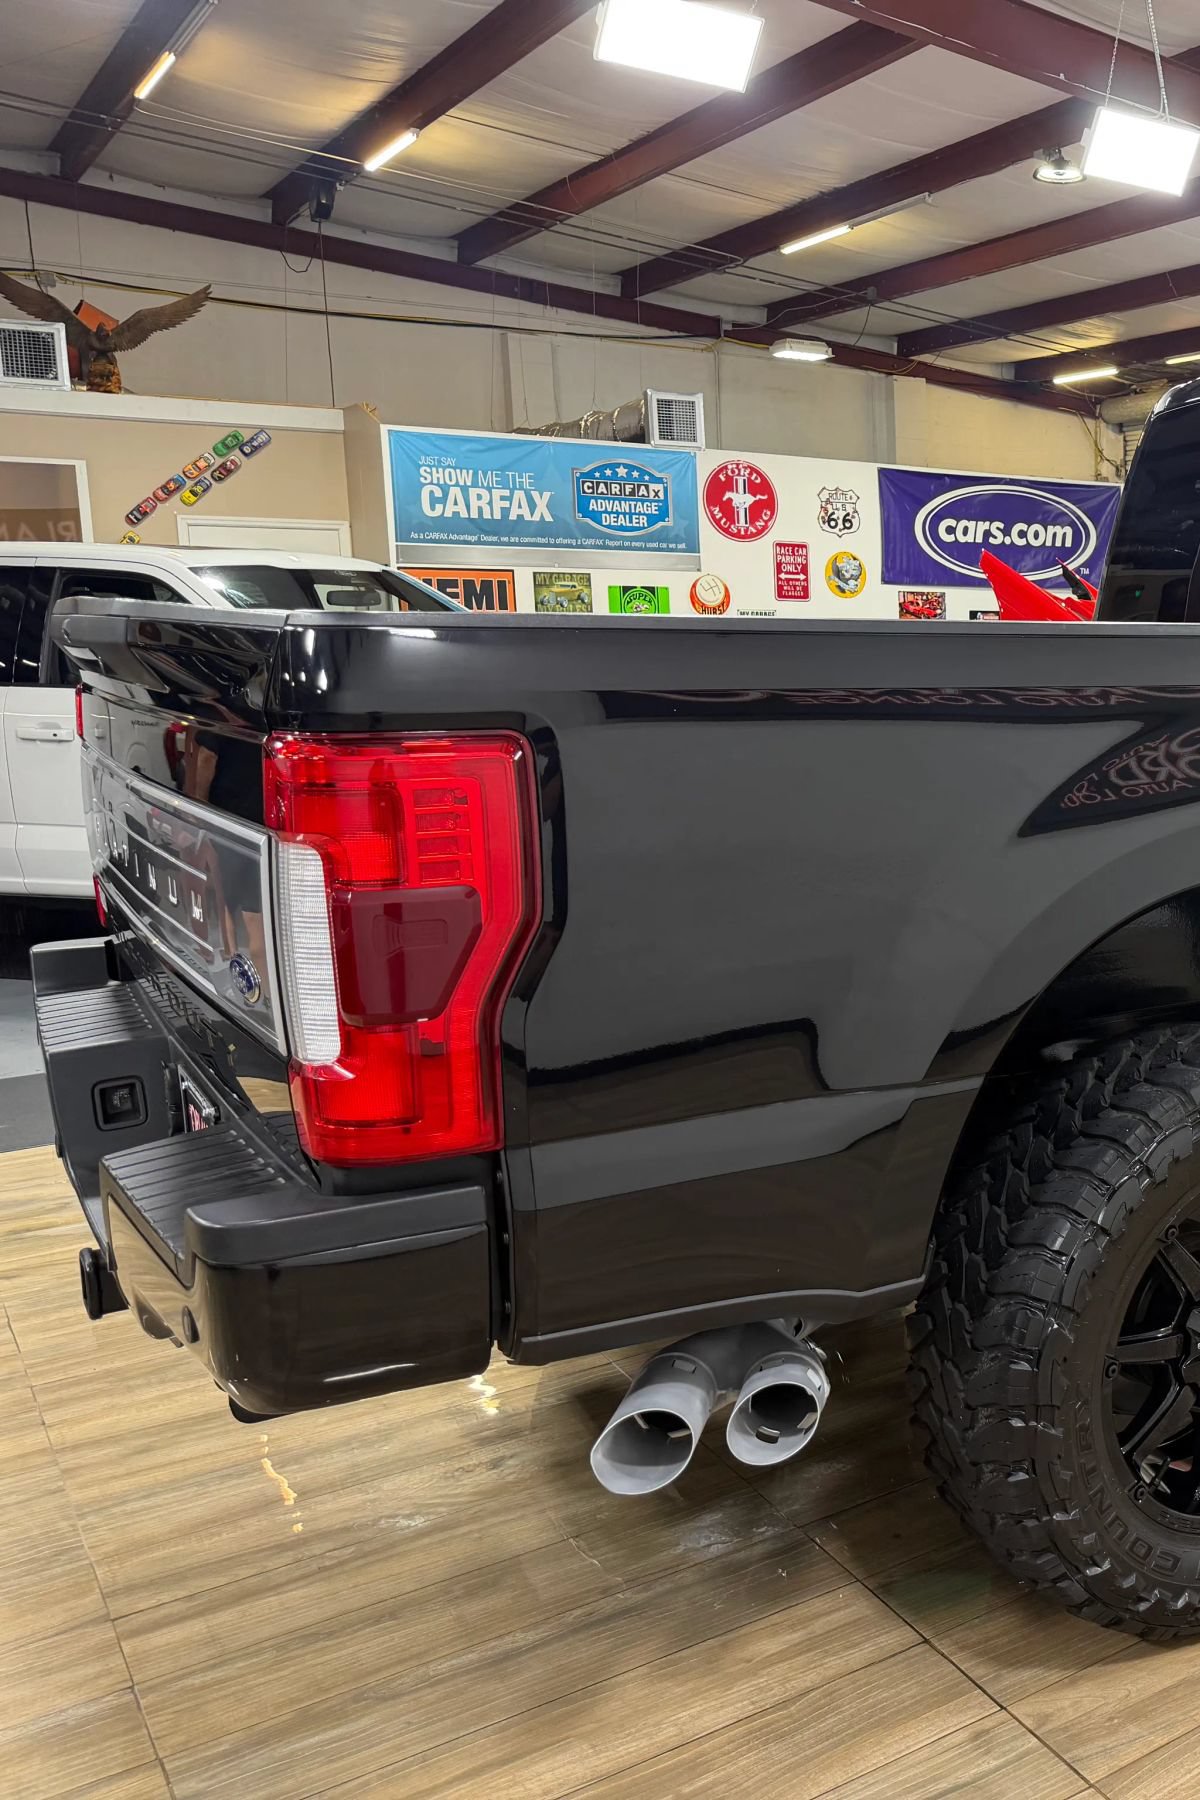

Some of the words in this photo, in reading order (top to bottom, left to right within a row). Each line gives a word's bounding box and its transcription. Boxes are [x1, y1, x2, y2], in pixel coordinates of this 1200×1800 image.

[418, 455, 440, 465] JUST
[441, 457, 456, 467] SAY
[420, 466, 474, 486] SHOW
[478, 470, 503, 488] ME
[505, 471, 536, 490] THE
[718, 465, 762, 484] FORD
[582, 480, 662, 499] CARFAX
[828, 492, 849, 502] ROUTE
[420, 484, 555, 522] CARFAX
[588, 498, 660, 515] ADVANTAGE
[601, 513, 648, 528] DEALER
[710, 503, 772, 536] MUSTANG
[827, 511, 854, 532] 66
[410, 531, 418, 539] As
[424, 532, 448, 540] CARFAX
[448, 533, 478, 542] Advantage
[519, 535, 548, 544] committed
[555, 537, 577, 546] offering
[605, 538, 623, 547] Report
[937, 518, 1073, 548] cars.com
[776, 545, 793, 555] RACE
[794, 546, 807, 556] CAR
[776, 554, 807, 564] PARKING
[781, 563, 802, 573] ONLY
[535, 573, 550, 585] MY
[552, 573, 590, 586] GARAGE
[421, 577, 510, 611] EMI
